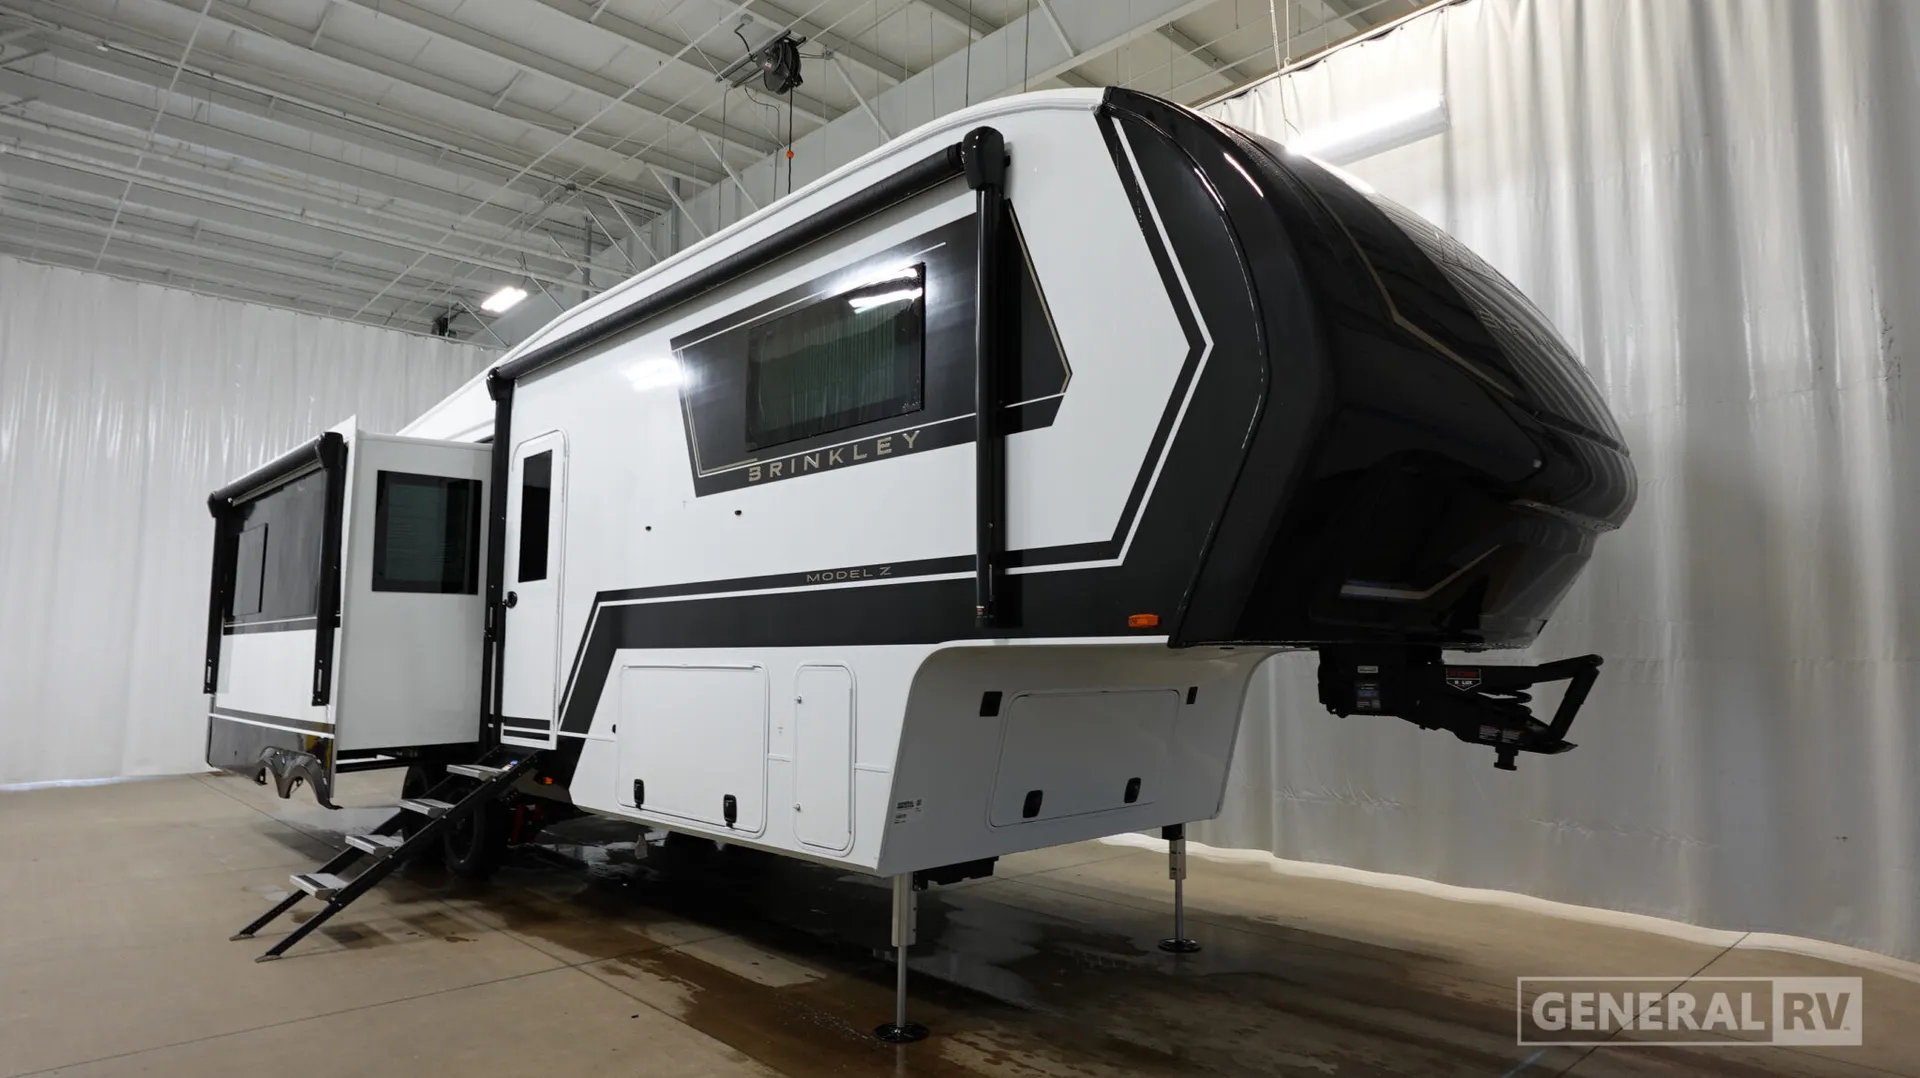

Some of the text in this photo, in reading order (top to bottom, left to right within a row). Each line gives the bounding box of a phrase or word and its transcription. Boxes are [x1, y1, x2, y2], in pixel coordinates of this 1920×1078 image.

[748, 429, 921, 482] BRINKLEY
[806, 565, 892, 582] MODEL Z
